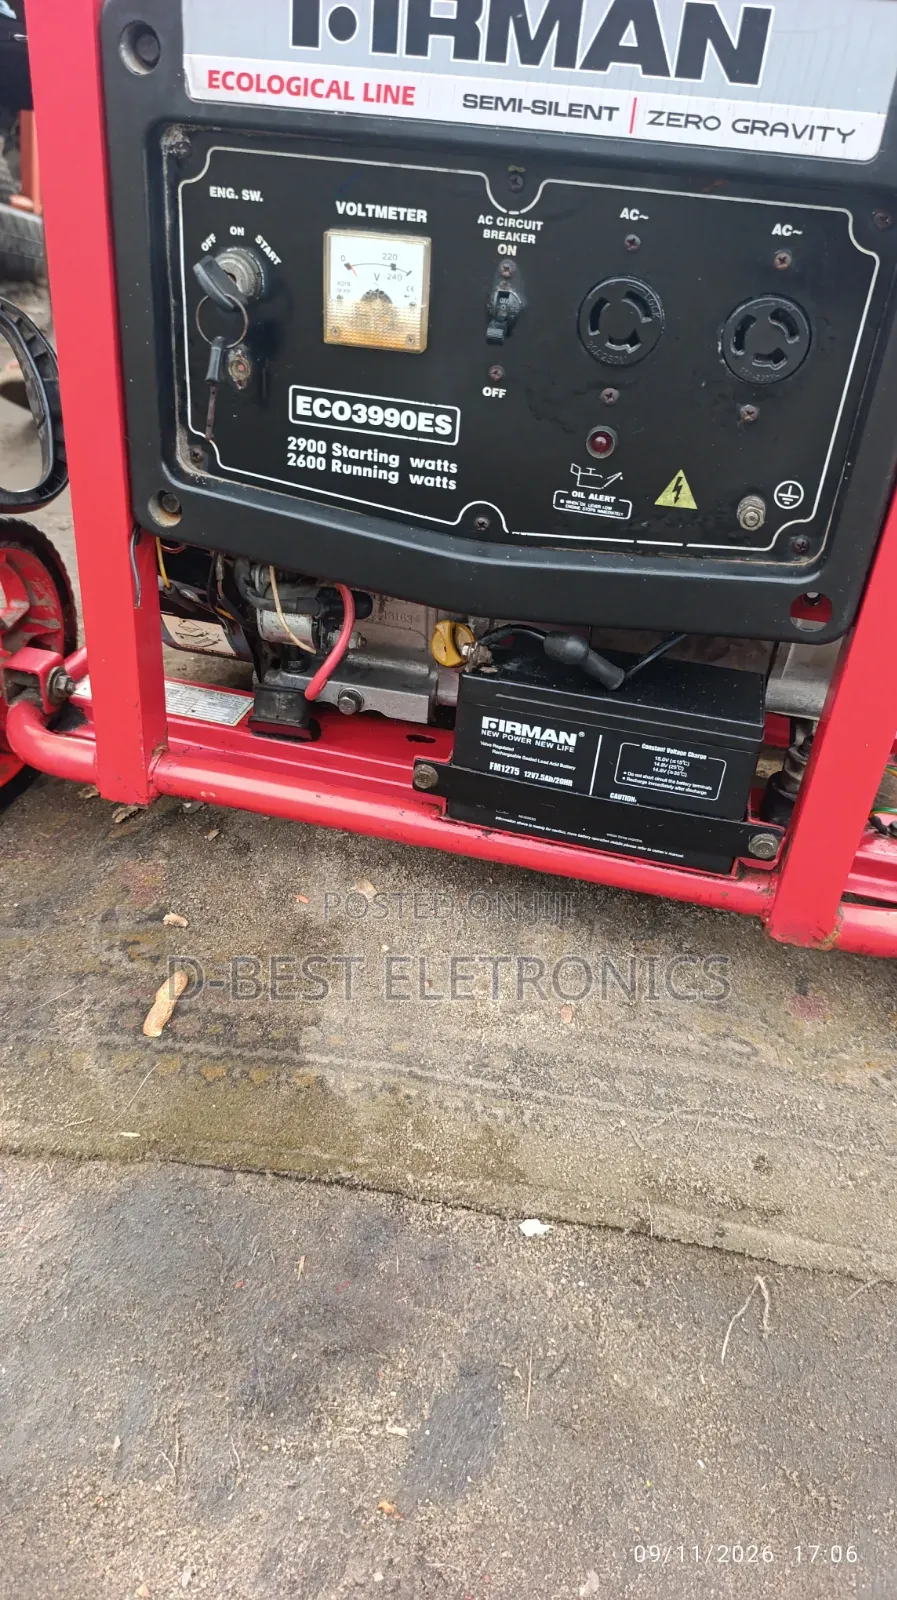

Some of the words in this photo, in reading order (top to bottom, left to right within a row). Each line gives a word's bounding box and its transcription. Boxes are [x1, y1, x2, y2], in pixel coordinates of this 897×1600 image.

[288, 0, 772, 86] FIRMAN
[207, 69, 355, 102] ECOLOGICAL
[363, 83, 415, 106] LINE
[463, 93, 619, 122] SEMI-SILENT
[647, 110, 721, 132] ZERO
[731, 118, 856, 145] GRAVITY
[209, 186, 238, 200] ENG.
[242, 190, 263, 202] SW.
[335, 201, 428, 223] VOLTMETER
[230, 226, 244, 236] ON
[477, 215, 493, 225] AC
[496, 216, 544, 231] CIRCUIT
[201, 233, 217, 252] OFF
[483, 229, 536, 244] BREAKER
[255, 235, 282, 266] START
[382, 253, 398, 261] 220
[497, 244, 517, 256] ON
[374, 273, 380, 281] V
[482, 387, 506, 398] OFF
[296, 395, 452, 435] ECO3990ES
[287, 436, 327, 454] 2900
[332, 442, 400, 467] Starting
[409, 457, 458, 473] watts
[287, 452, 326, 470] 2600
[331, 459, 399, 484] Running
[409, 473, 457, 490] watts
[571, 490, 585, 498] OIL
[588, 493, 616, 503] ALERT
[481, 729, 500, 738] NEW
[502, 733, 532, 745] POWER
[535, 741, 554, 749] NEW
[557, 744, 575, 753] LIFE
[641, 743, 666, 753] Constant
[666, 747, 687, 756] Voltage
[688, 751, 707, 760] Charge
[489, 761, 520, 776] FM1275
